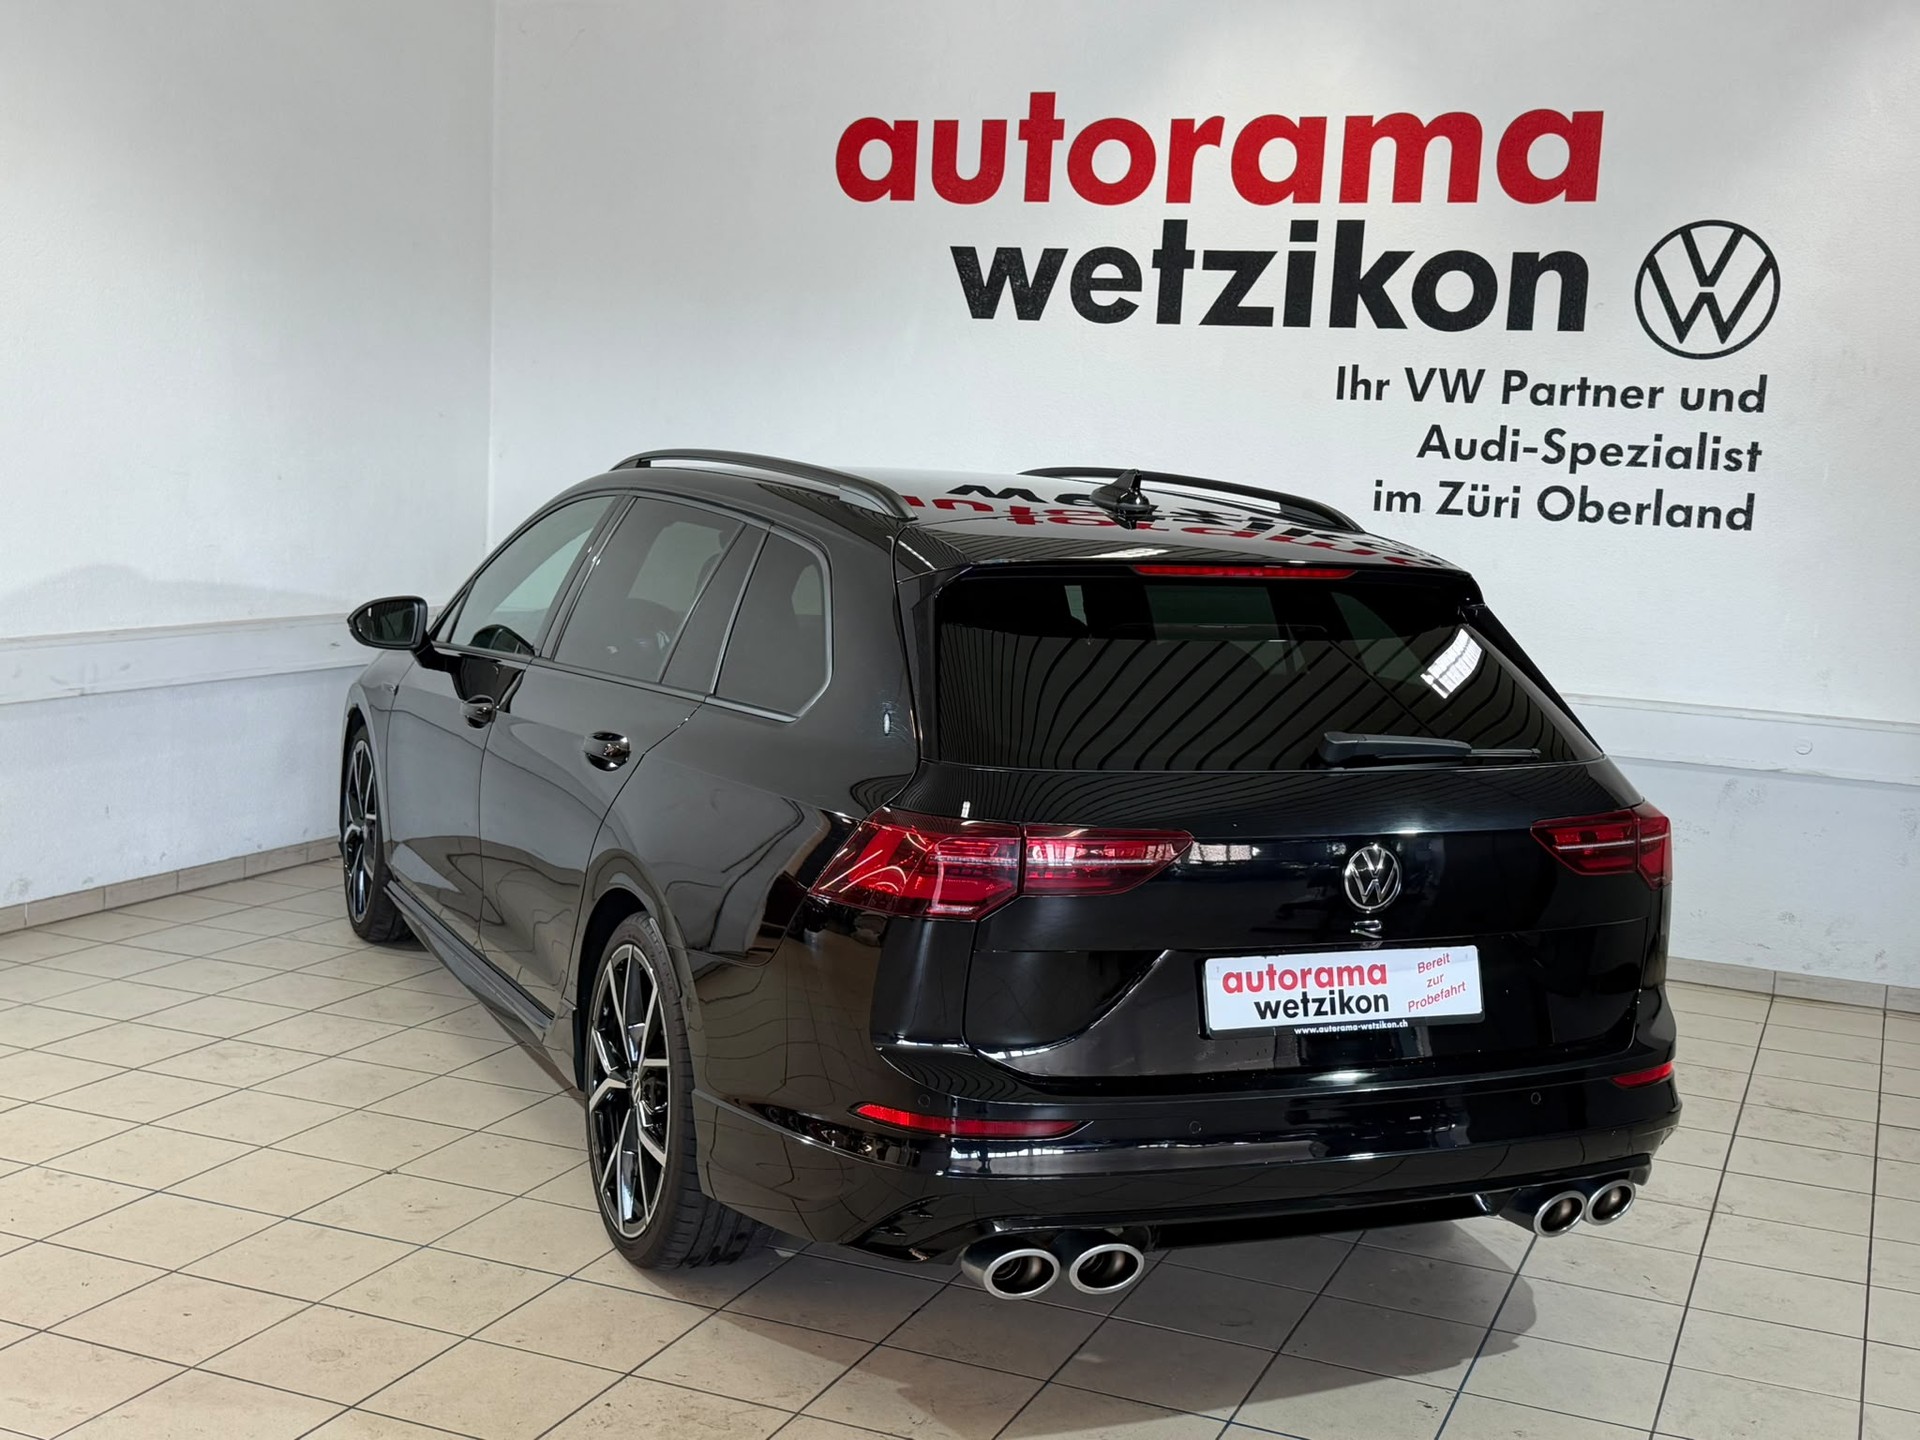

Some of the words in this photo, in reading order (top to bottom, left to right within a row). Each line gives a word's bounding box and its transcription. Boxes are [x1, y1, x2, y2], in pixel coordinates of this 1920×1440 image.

[836, 92, 1603, 205] autorama
[950, 219, 1589, 332] wetzikon
[1336, 364, 1390, 401] Ihr
[1404, 367, 1486, 404] VW
[1501, 369, 1665, 409] Partner
[1680, 374, 1768, 413] und
[1416, 424, 1763, 475] Audi-Spezialist
[1373, 479, 1421, 514] im
[1435, 480, 1521, 519] Züri
[1537, 485, 1756, 531] Oberland
[1222, 964, 1388, 994] autorama
[1417, 953, 1451, 974] Bereit
[1426, 973, 1445, 988] zur
[1254, 989, 1389, 1020] wetzikon
[1407, 981, 1466, 1013] Probefahrt
[1294, 1019, 1408, 1034] www.autorama-wetzikon.ch
